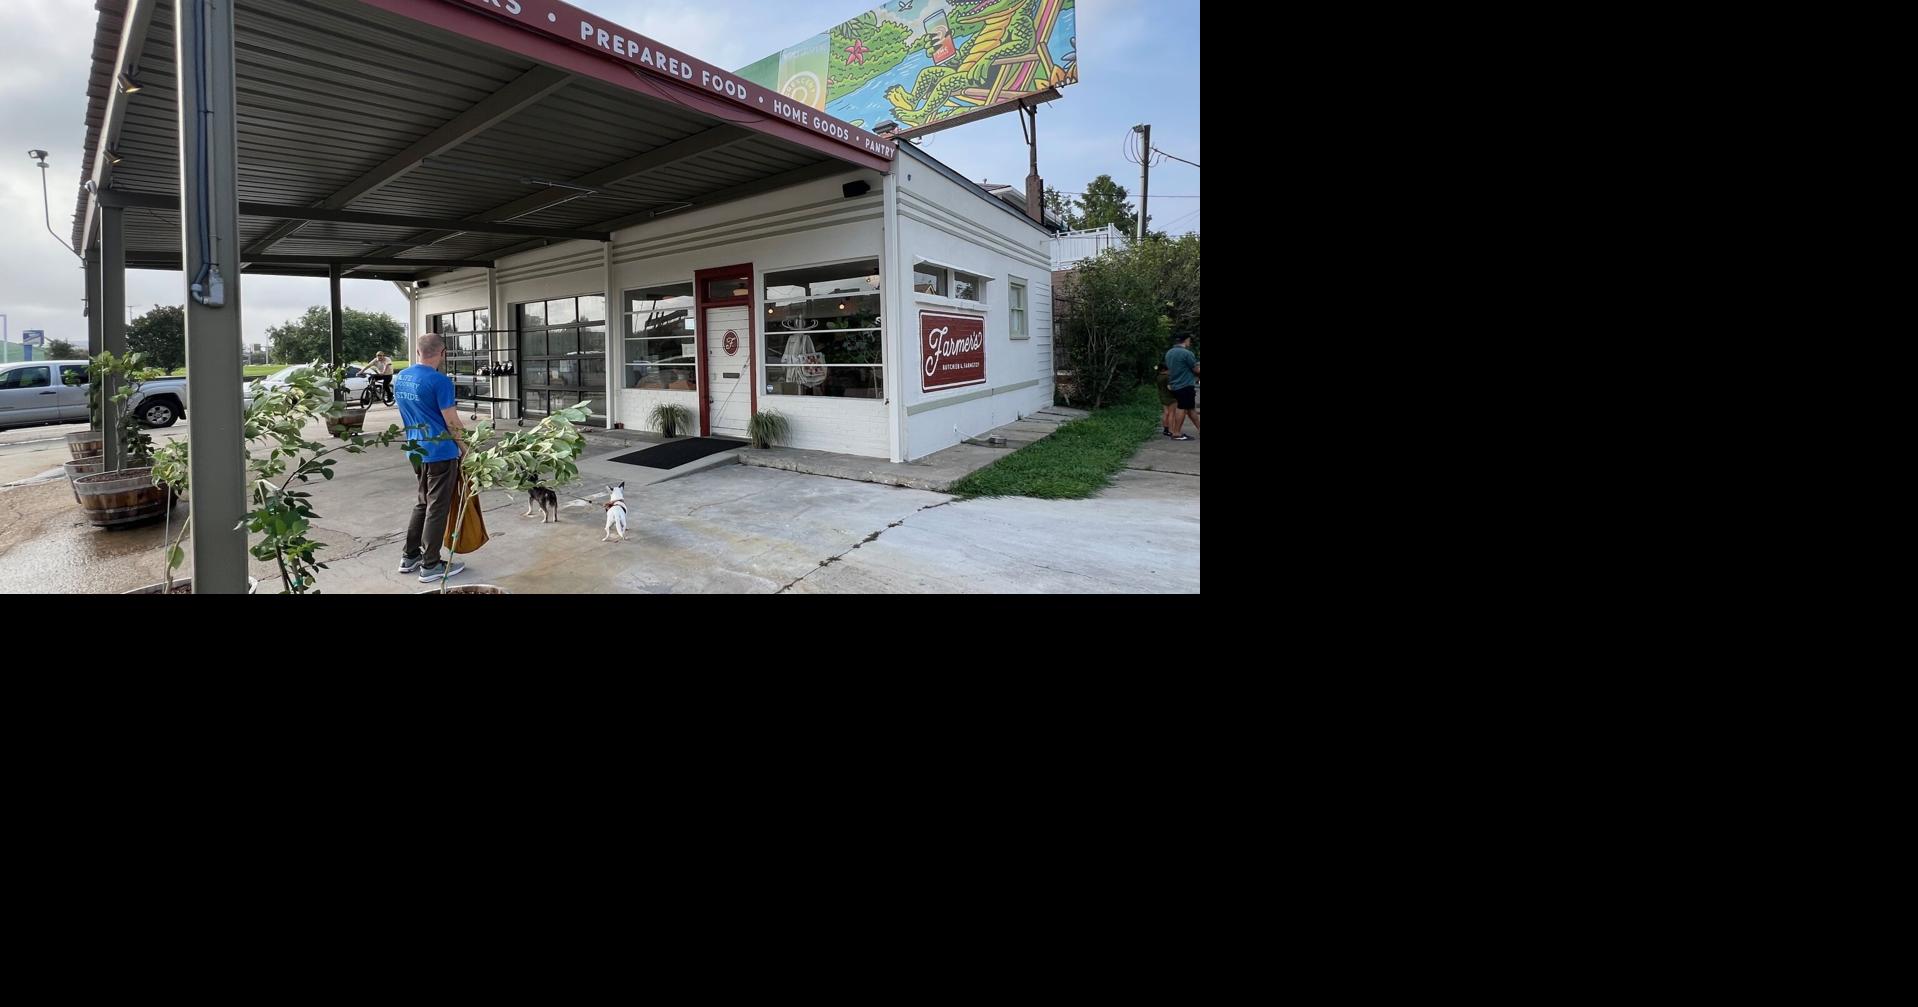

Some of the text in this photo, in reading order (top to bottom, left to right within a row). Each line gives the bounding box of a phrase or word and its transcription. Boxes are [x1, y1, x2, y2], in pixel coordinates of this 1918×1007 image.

[580, 20, 693, 80] PREPARED
[702, 70, 747, 100] FOOD
[774, 99, 808, 125] HOME
[813, 118, 849, 141] GOODS
[865, 137, 895, 158] PANTRY
[925, 326, 983, 377] Farmer's
